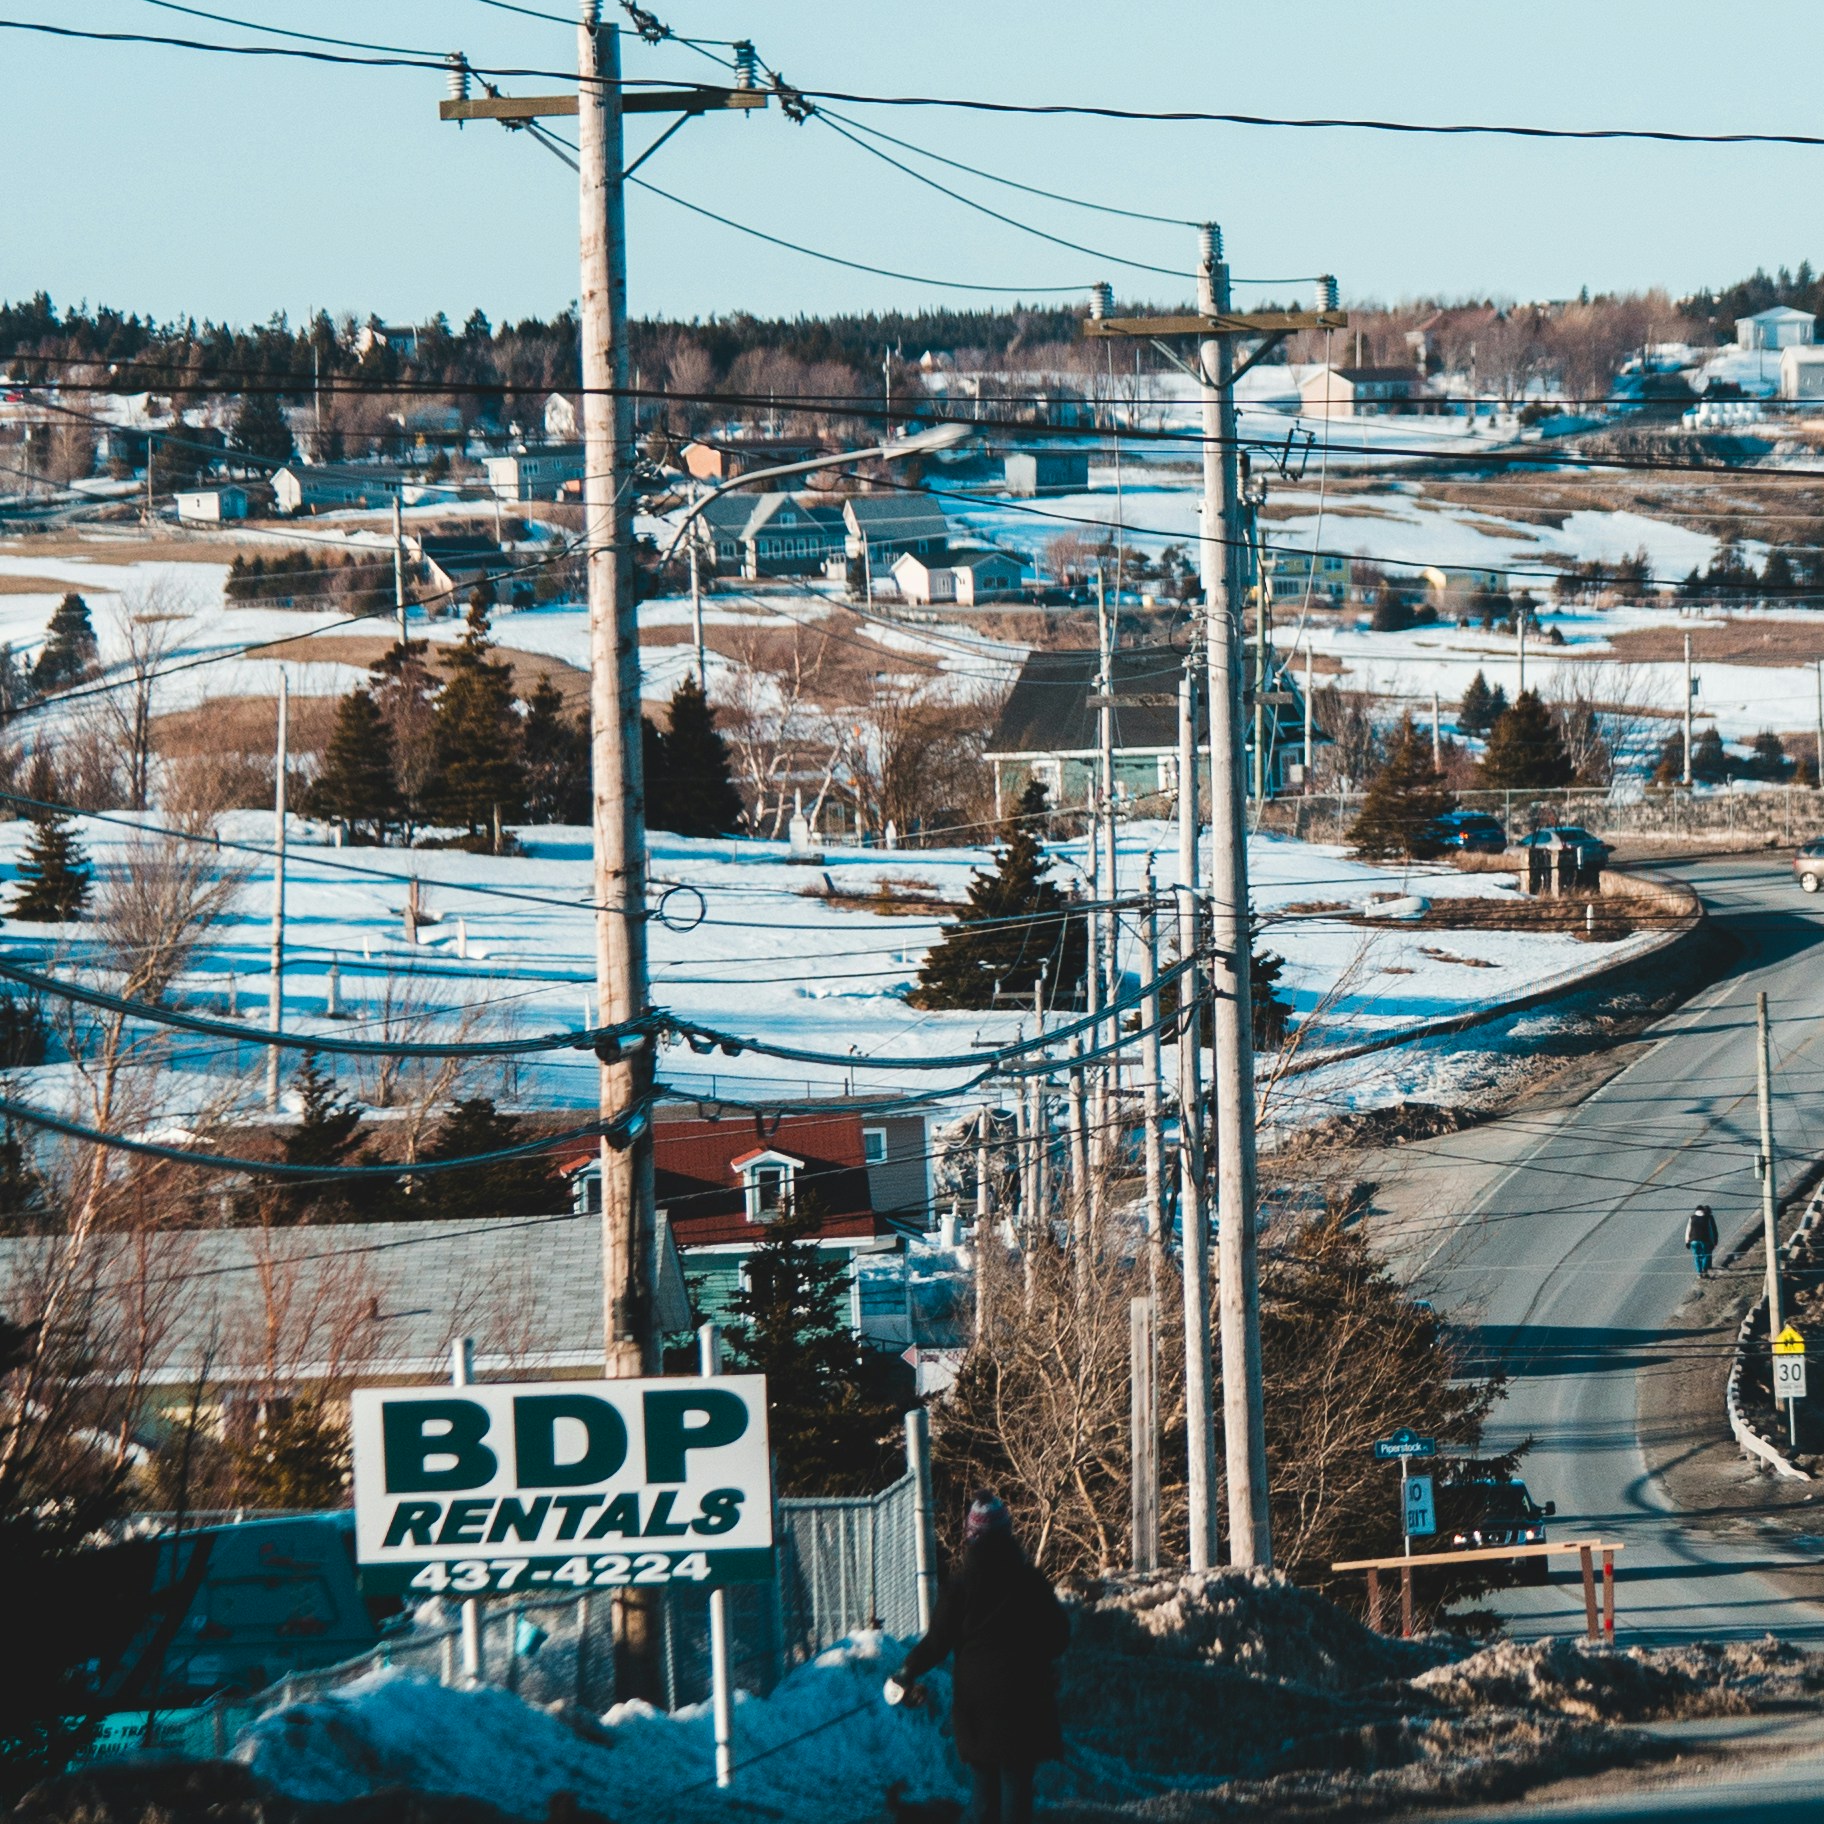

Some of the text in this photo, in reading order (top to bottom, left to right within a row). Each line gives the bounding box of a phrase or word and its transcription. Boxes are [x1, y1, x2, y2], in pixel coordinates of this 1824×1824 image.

[1779, 1363, 1801, 1382] 30
[381, 1388, 749, 1494] BDP
[381, 1487, 746, 1548] RENTALS
[410, 1551, 712, 1593] 437-4224
